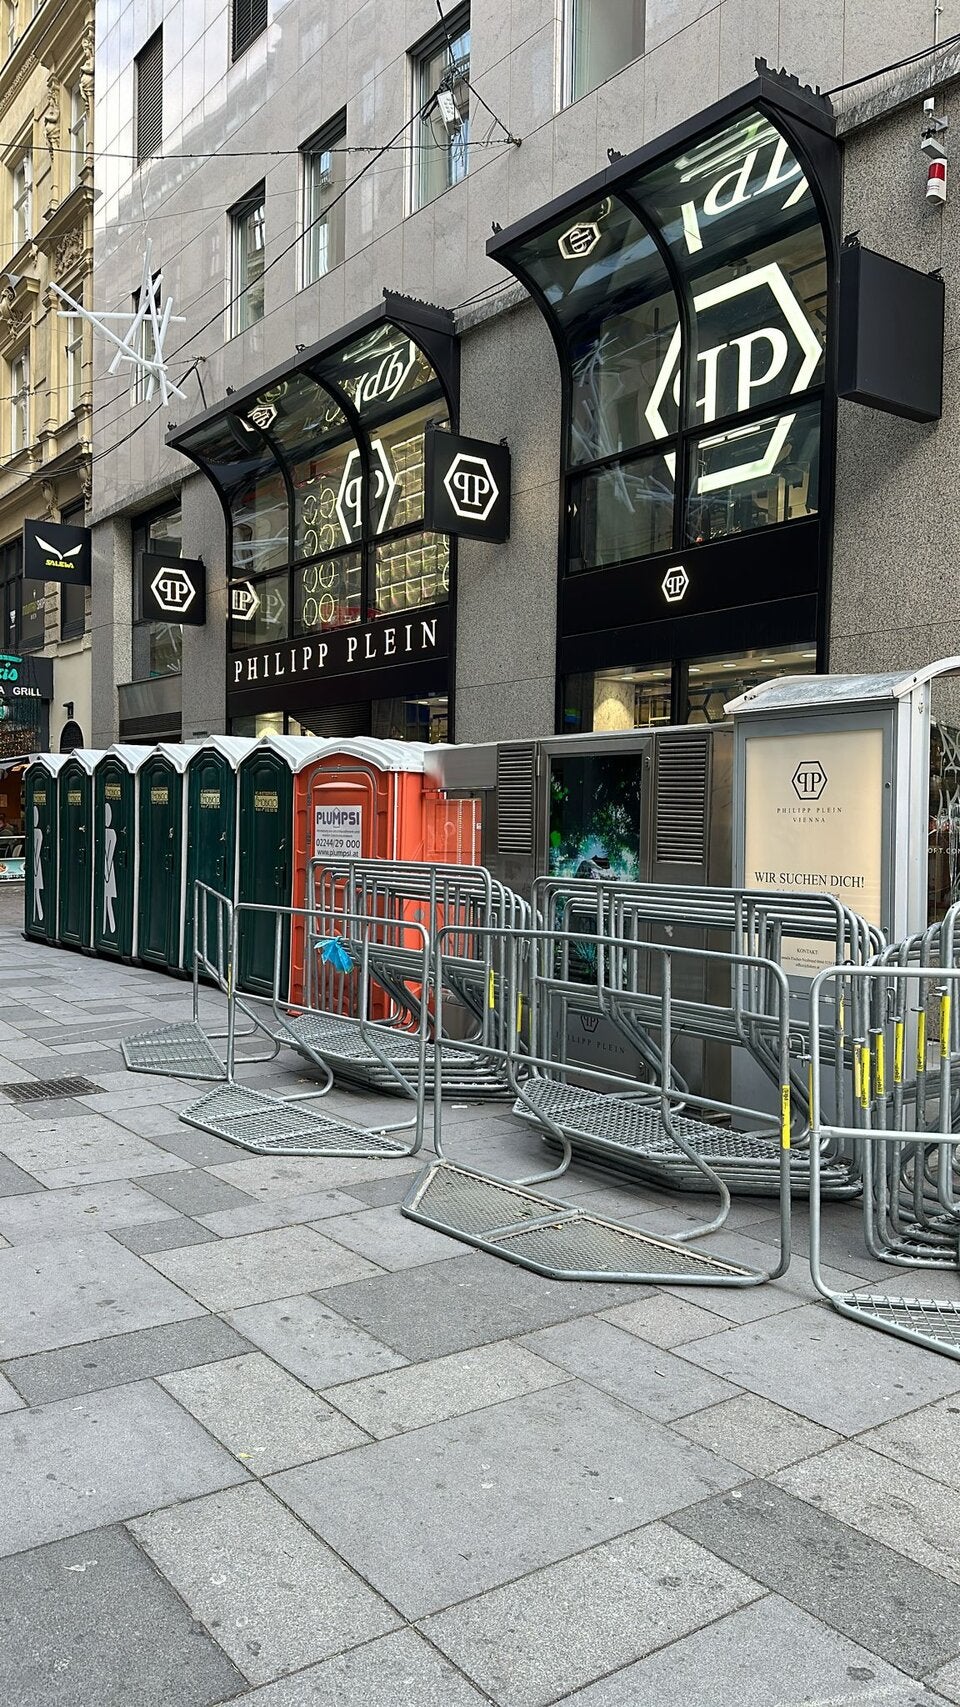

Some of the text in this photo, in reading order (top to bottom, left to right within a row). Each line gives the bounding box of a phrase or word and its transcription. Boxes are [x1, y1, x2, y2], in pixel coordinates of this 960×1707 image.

[234, 618, 438, 683] PHILIPP PLEIN
[12, 686, 42, 697] GRILL
[316, 811, 360, 826] PLUMPSI
[754, 871, 865, 888] WIR SUCHEN DICH!
[796, 948, 819, 956] KONTAKT
